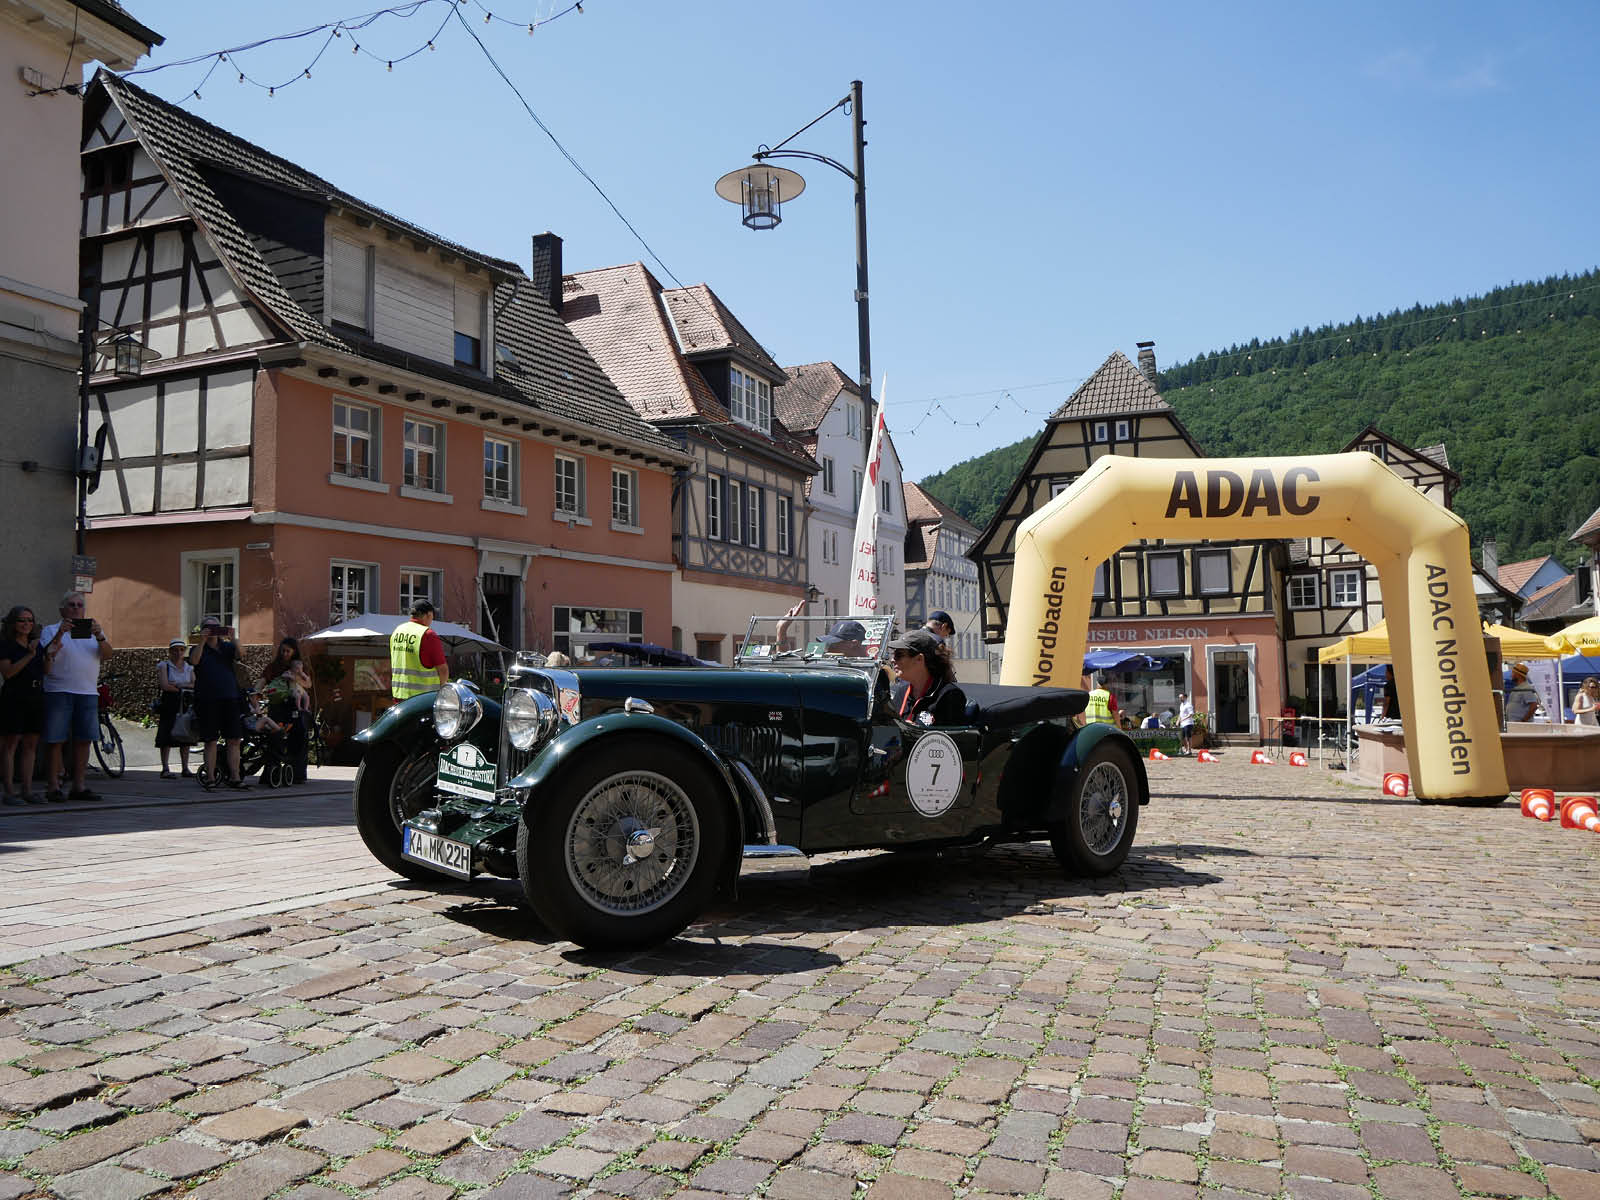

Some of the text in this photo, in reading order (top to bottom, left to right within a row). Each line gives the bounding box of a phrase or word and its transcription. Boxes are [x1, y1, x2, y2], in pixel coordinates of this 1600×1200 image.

[1165, 467, 1320, 518] ADAC
[394, 632, 417, 645] ADAC
[1032, 566, 1067, 688] Nordbaden
[1088, 627, 1209, 642] ISEUR NELSON
[1425, 564, 1472, 775] ADAC Nordbaden
[465, 751, 470, 761] 7
[931, 764, 941, 785] 7
[410, 832, 470, 871] KA MK 22H
